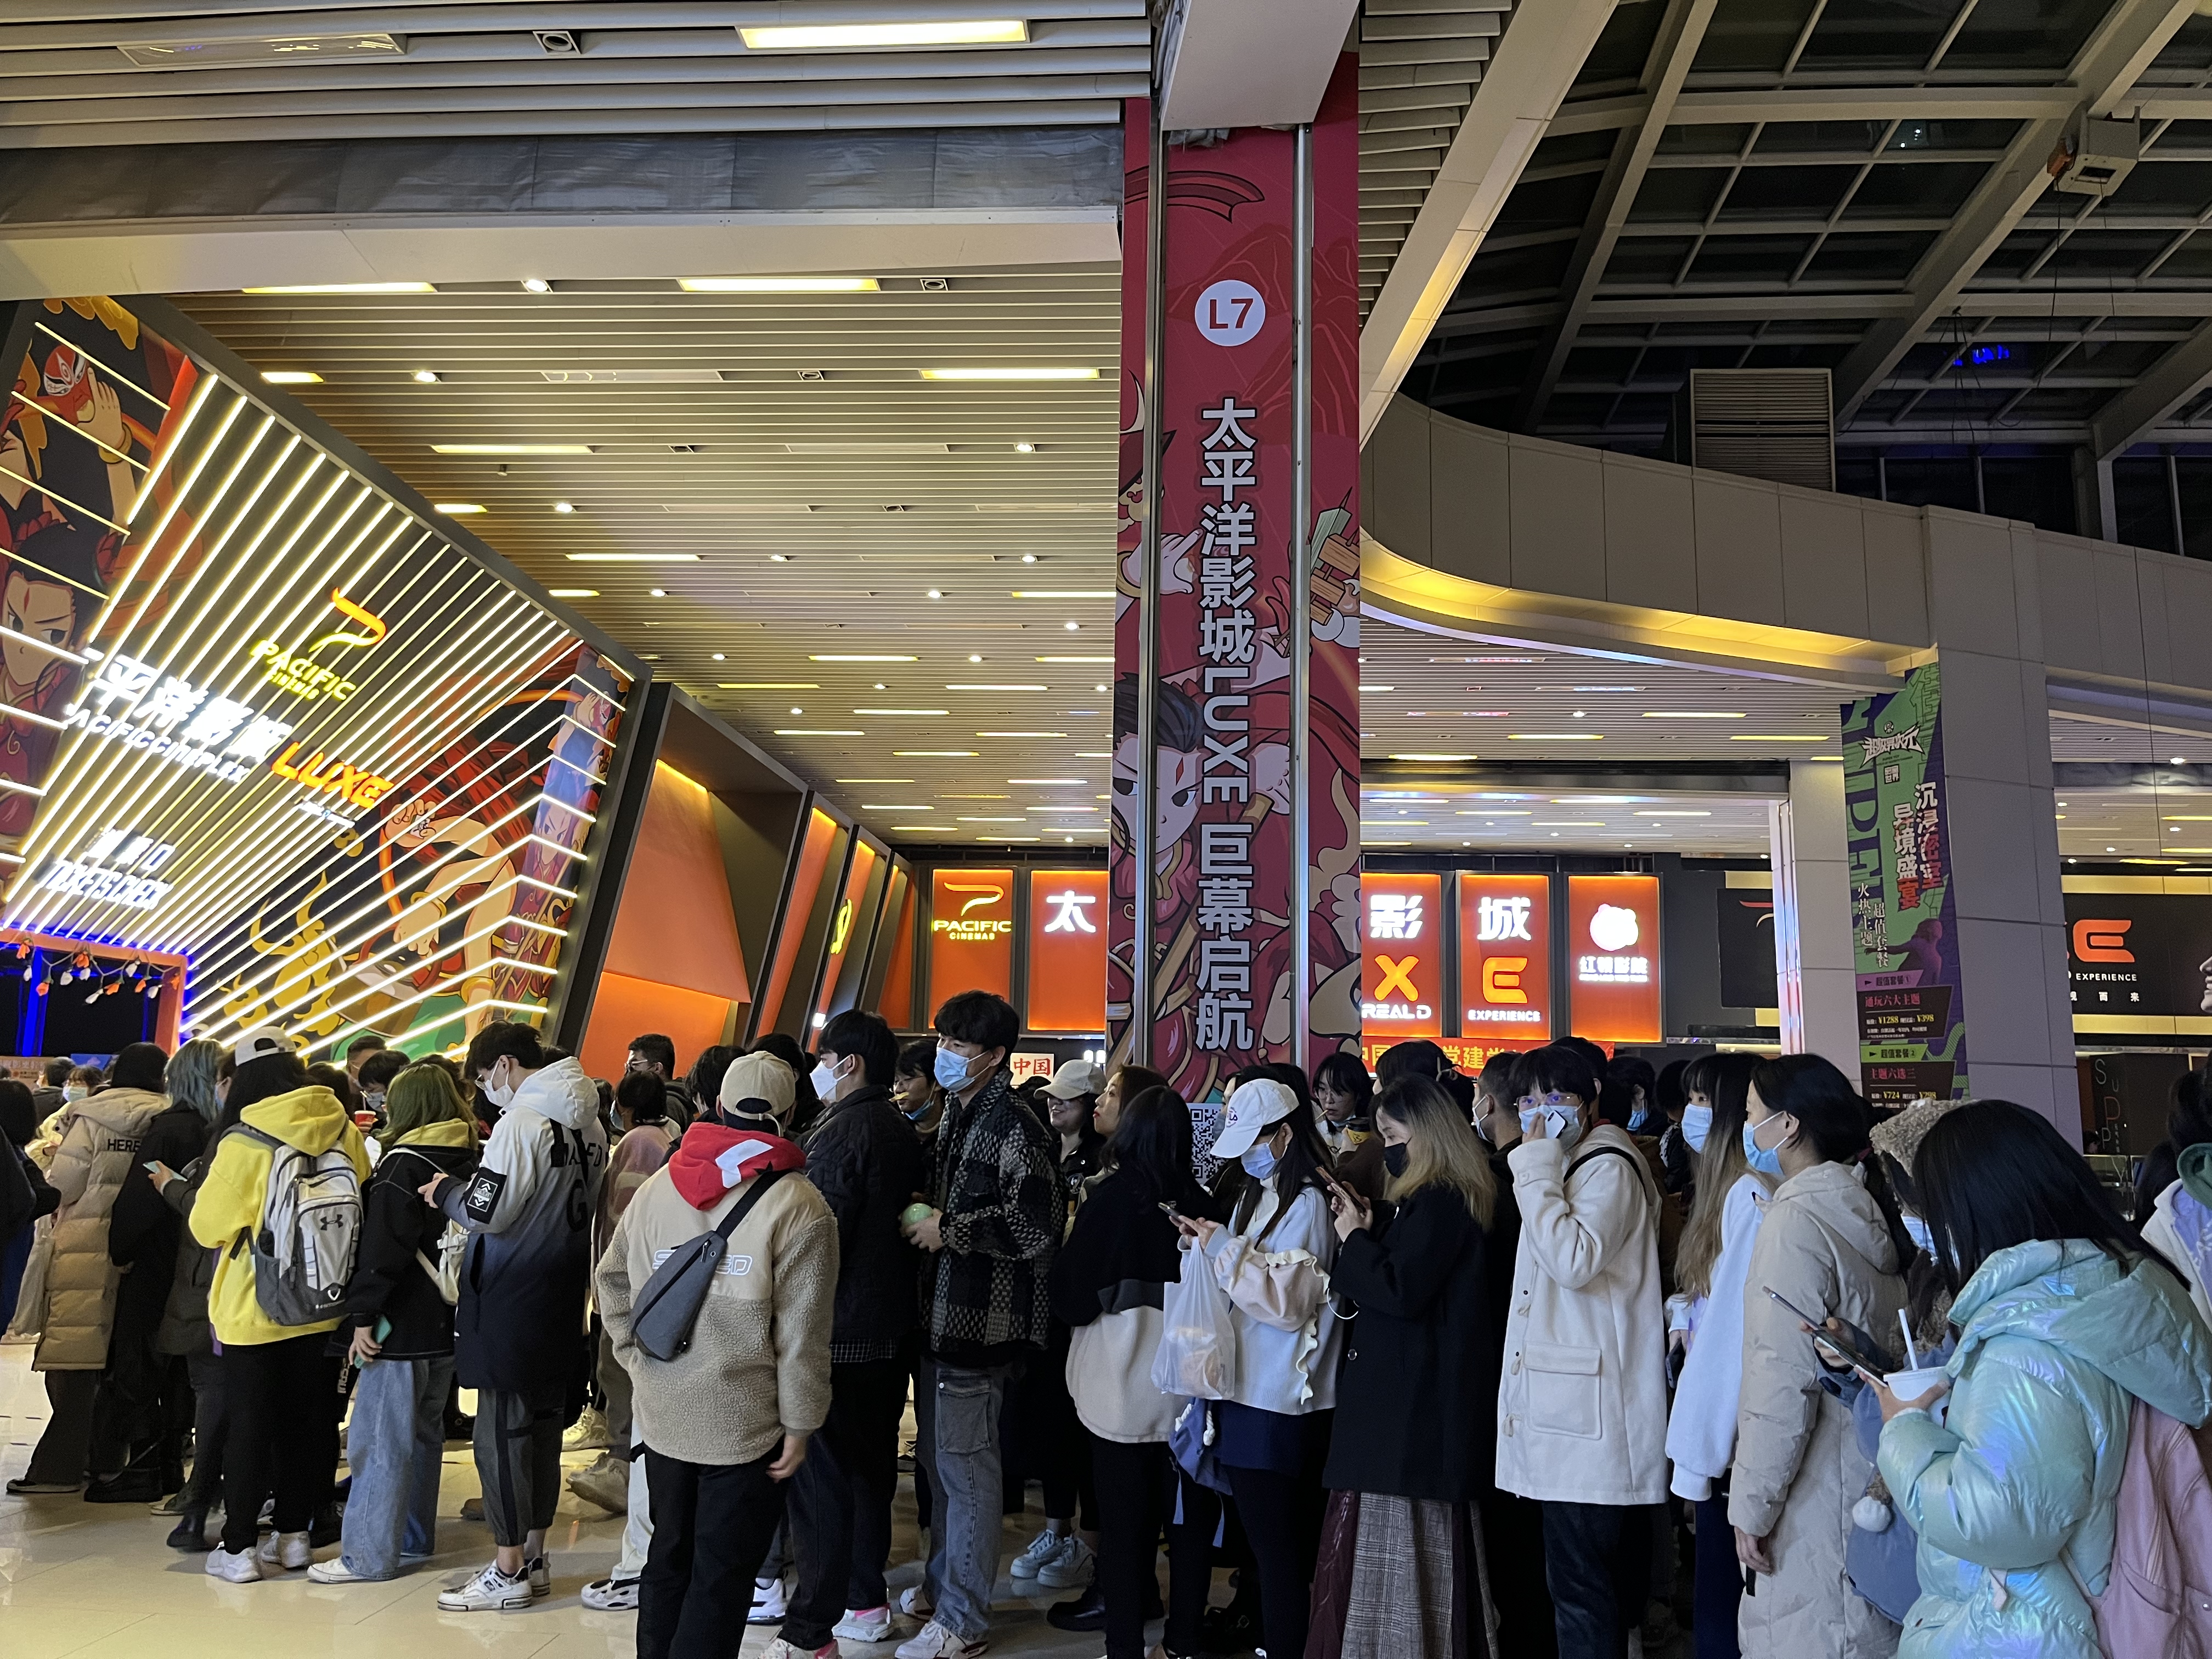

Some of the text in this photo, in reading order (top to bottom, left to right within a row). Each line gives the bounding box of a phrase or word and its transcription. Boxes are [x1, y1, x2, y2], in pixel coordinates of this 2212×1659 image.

[1209, 298, 1254, 330] L7
[250, 640, 357, 701] PACIFIC
[272, 742, 393, 809] LUXE
[1893, 803, 1920, 910] 异境盛宴
[1914, 782, 1944, 889] 沉浸密室
[933, 919, 1012, 933] PACIFIC
[1045, 890, 1097, 933] 太
[1370, 895, 1423, 939] 影
[1477, 897, 1532, 941] 城
[1858, 882, 1873, 946] 火热主题
[949, 933, 996, 941] CINEMAS
[1195, 824, 1253, 1050] 巨幕启航
[1874, 902, 1889, 968] 超值套餐
[2076, 973, 2137, 981] EXPERIENCE
[1468, 1009, 1541, 1023] EXPERIENCE
[1878, 1015, 1899, 1024] ¥1288
[1916, 1014, 1934, 1022] ¥398
[1013, 1058, 1051, 1076] 中国
[1883, 1091, 1900, 1099] ¥724
